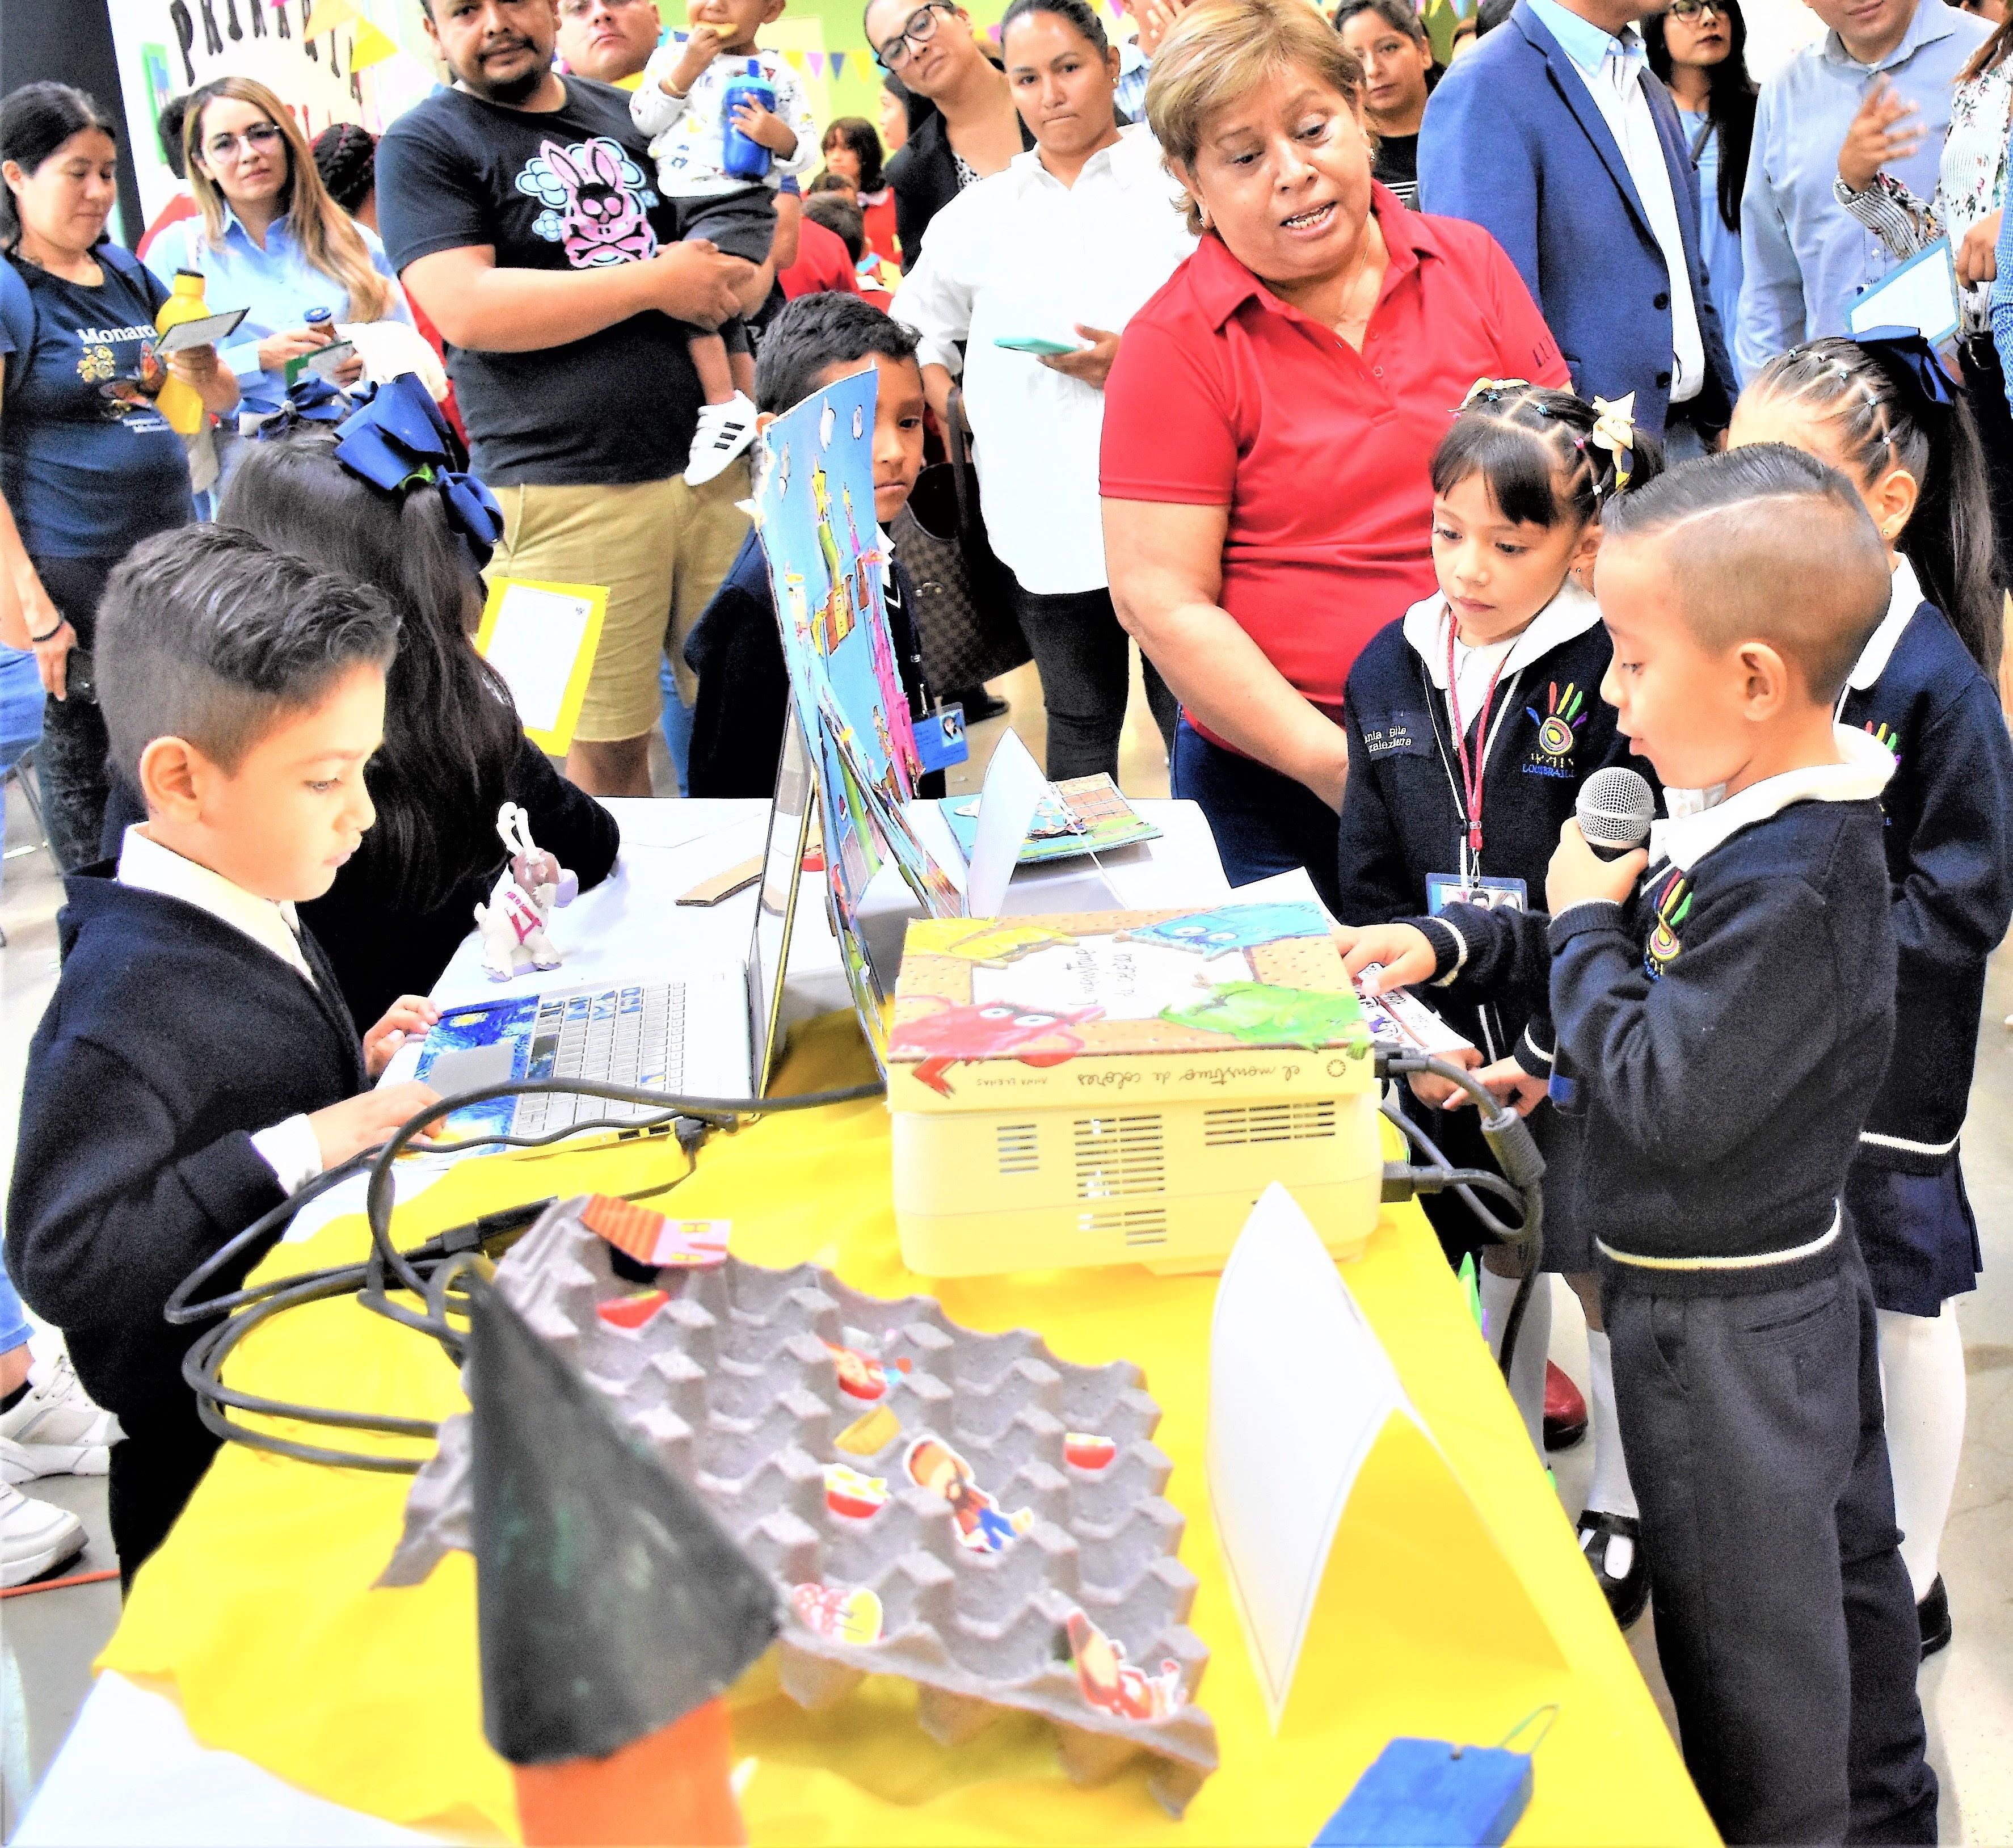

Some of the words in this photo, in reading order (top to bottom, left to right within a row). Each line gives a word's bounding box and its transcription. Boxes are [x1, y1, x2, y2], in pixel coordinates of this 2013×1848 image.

[1078, 1071, 1141, 1089] colores
[1152, 1070, 1171, 1085] de
[1178, 1066, 1276, 1085] monstruo
[1281, 1064, 1300, 1081] el
